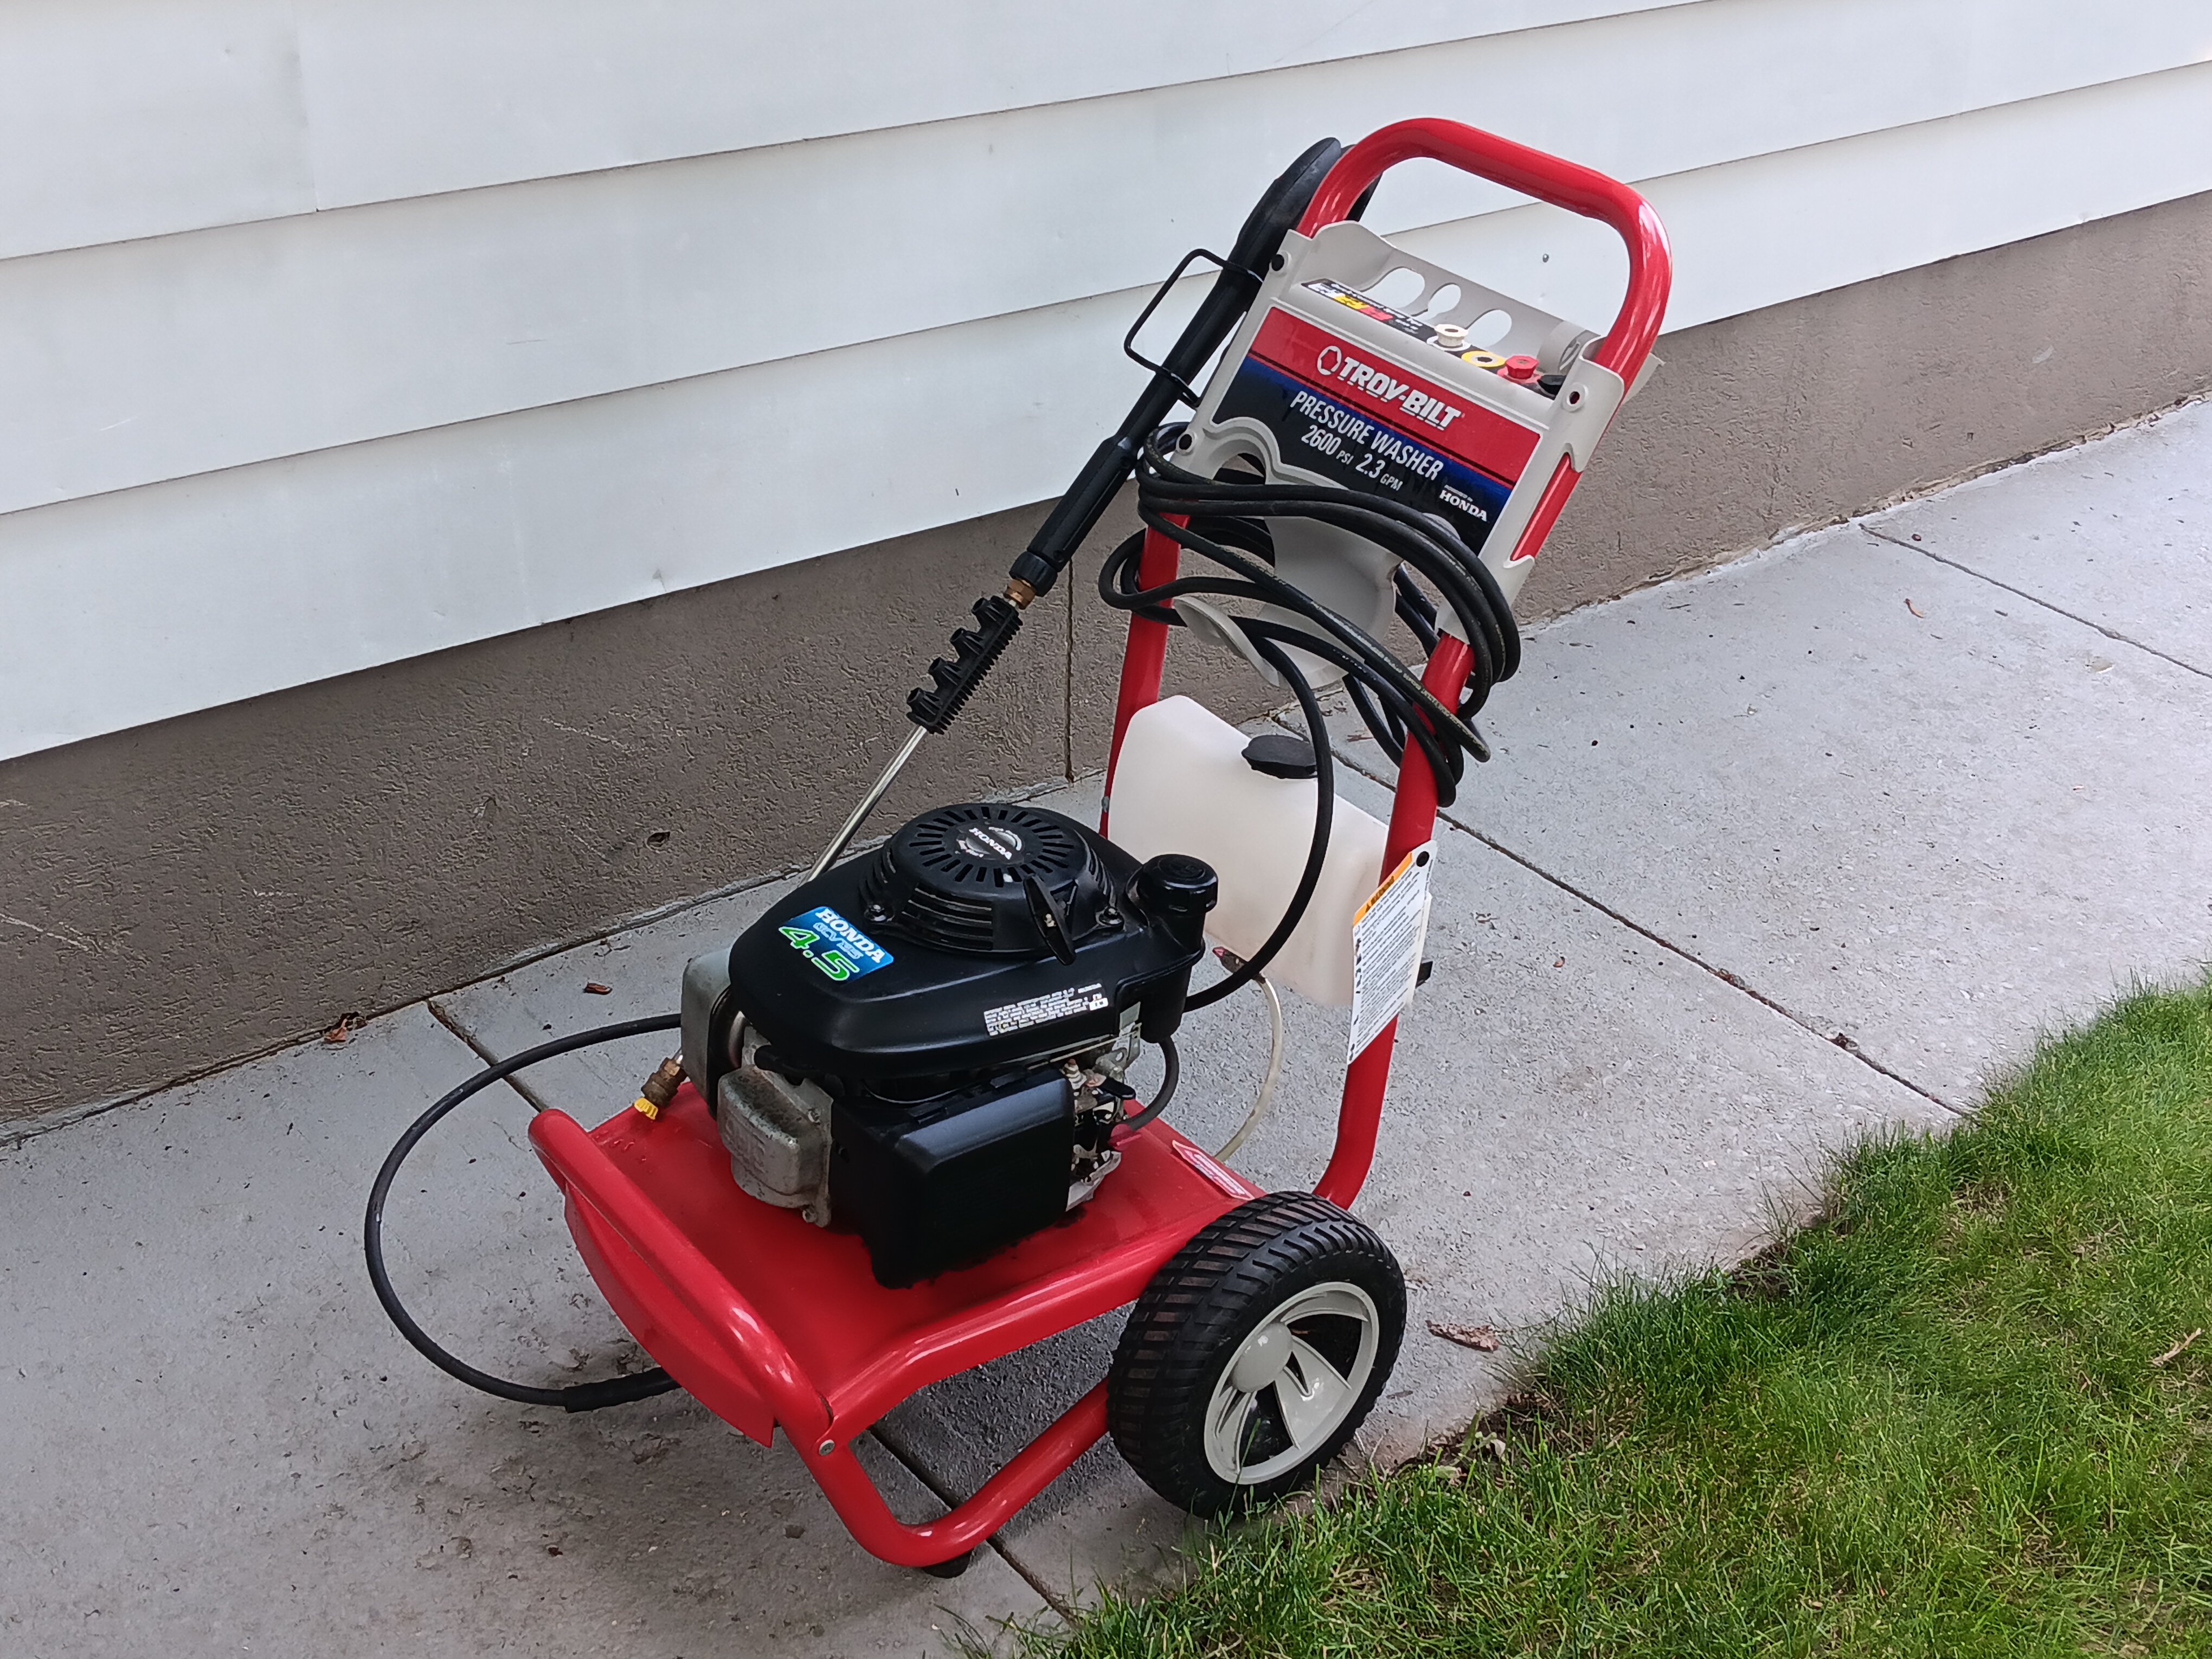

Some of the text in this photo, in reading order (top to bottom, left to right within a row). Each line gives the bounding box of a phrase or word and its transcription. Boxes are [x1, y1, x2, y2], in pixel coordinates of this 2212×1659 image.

[1337, 356, 1462, 430] TROY-BILT
[1290, 390, 1444, 480] PRESSURE WASHER
[1301, 424, 1403, 491] 2600 PSI 2.3 GPM
[1439, 490, 1487, 522] HONDA
[969, 827, 1012, 860] HONDA
[779, 926, 860, 981] 4.5
[815, 908, 886, 963] HONDA
